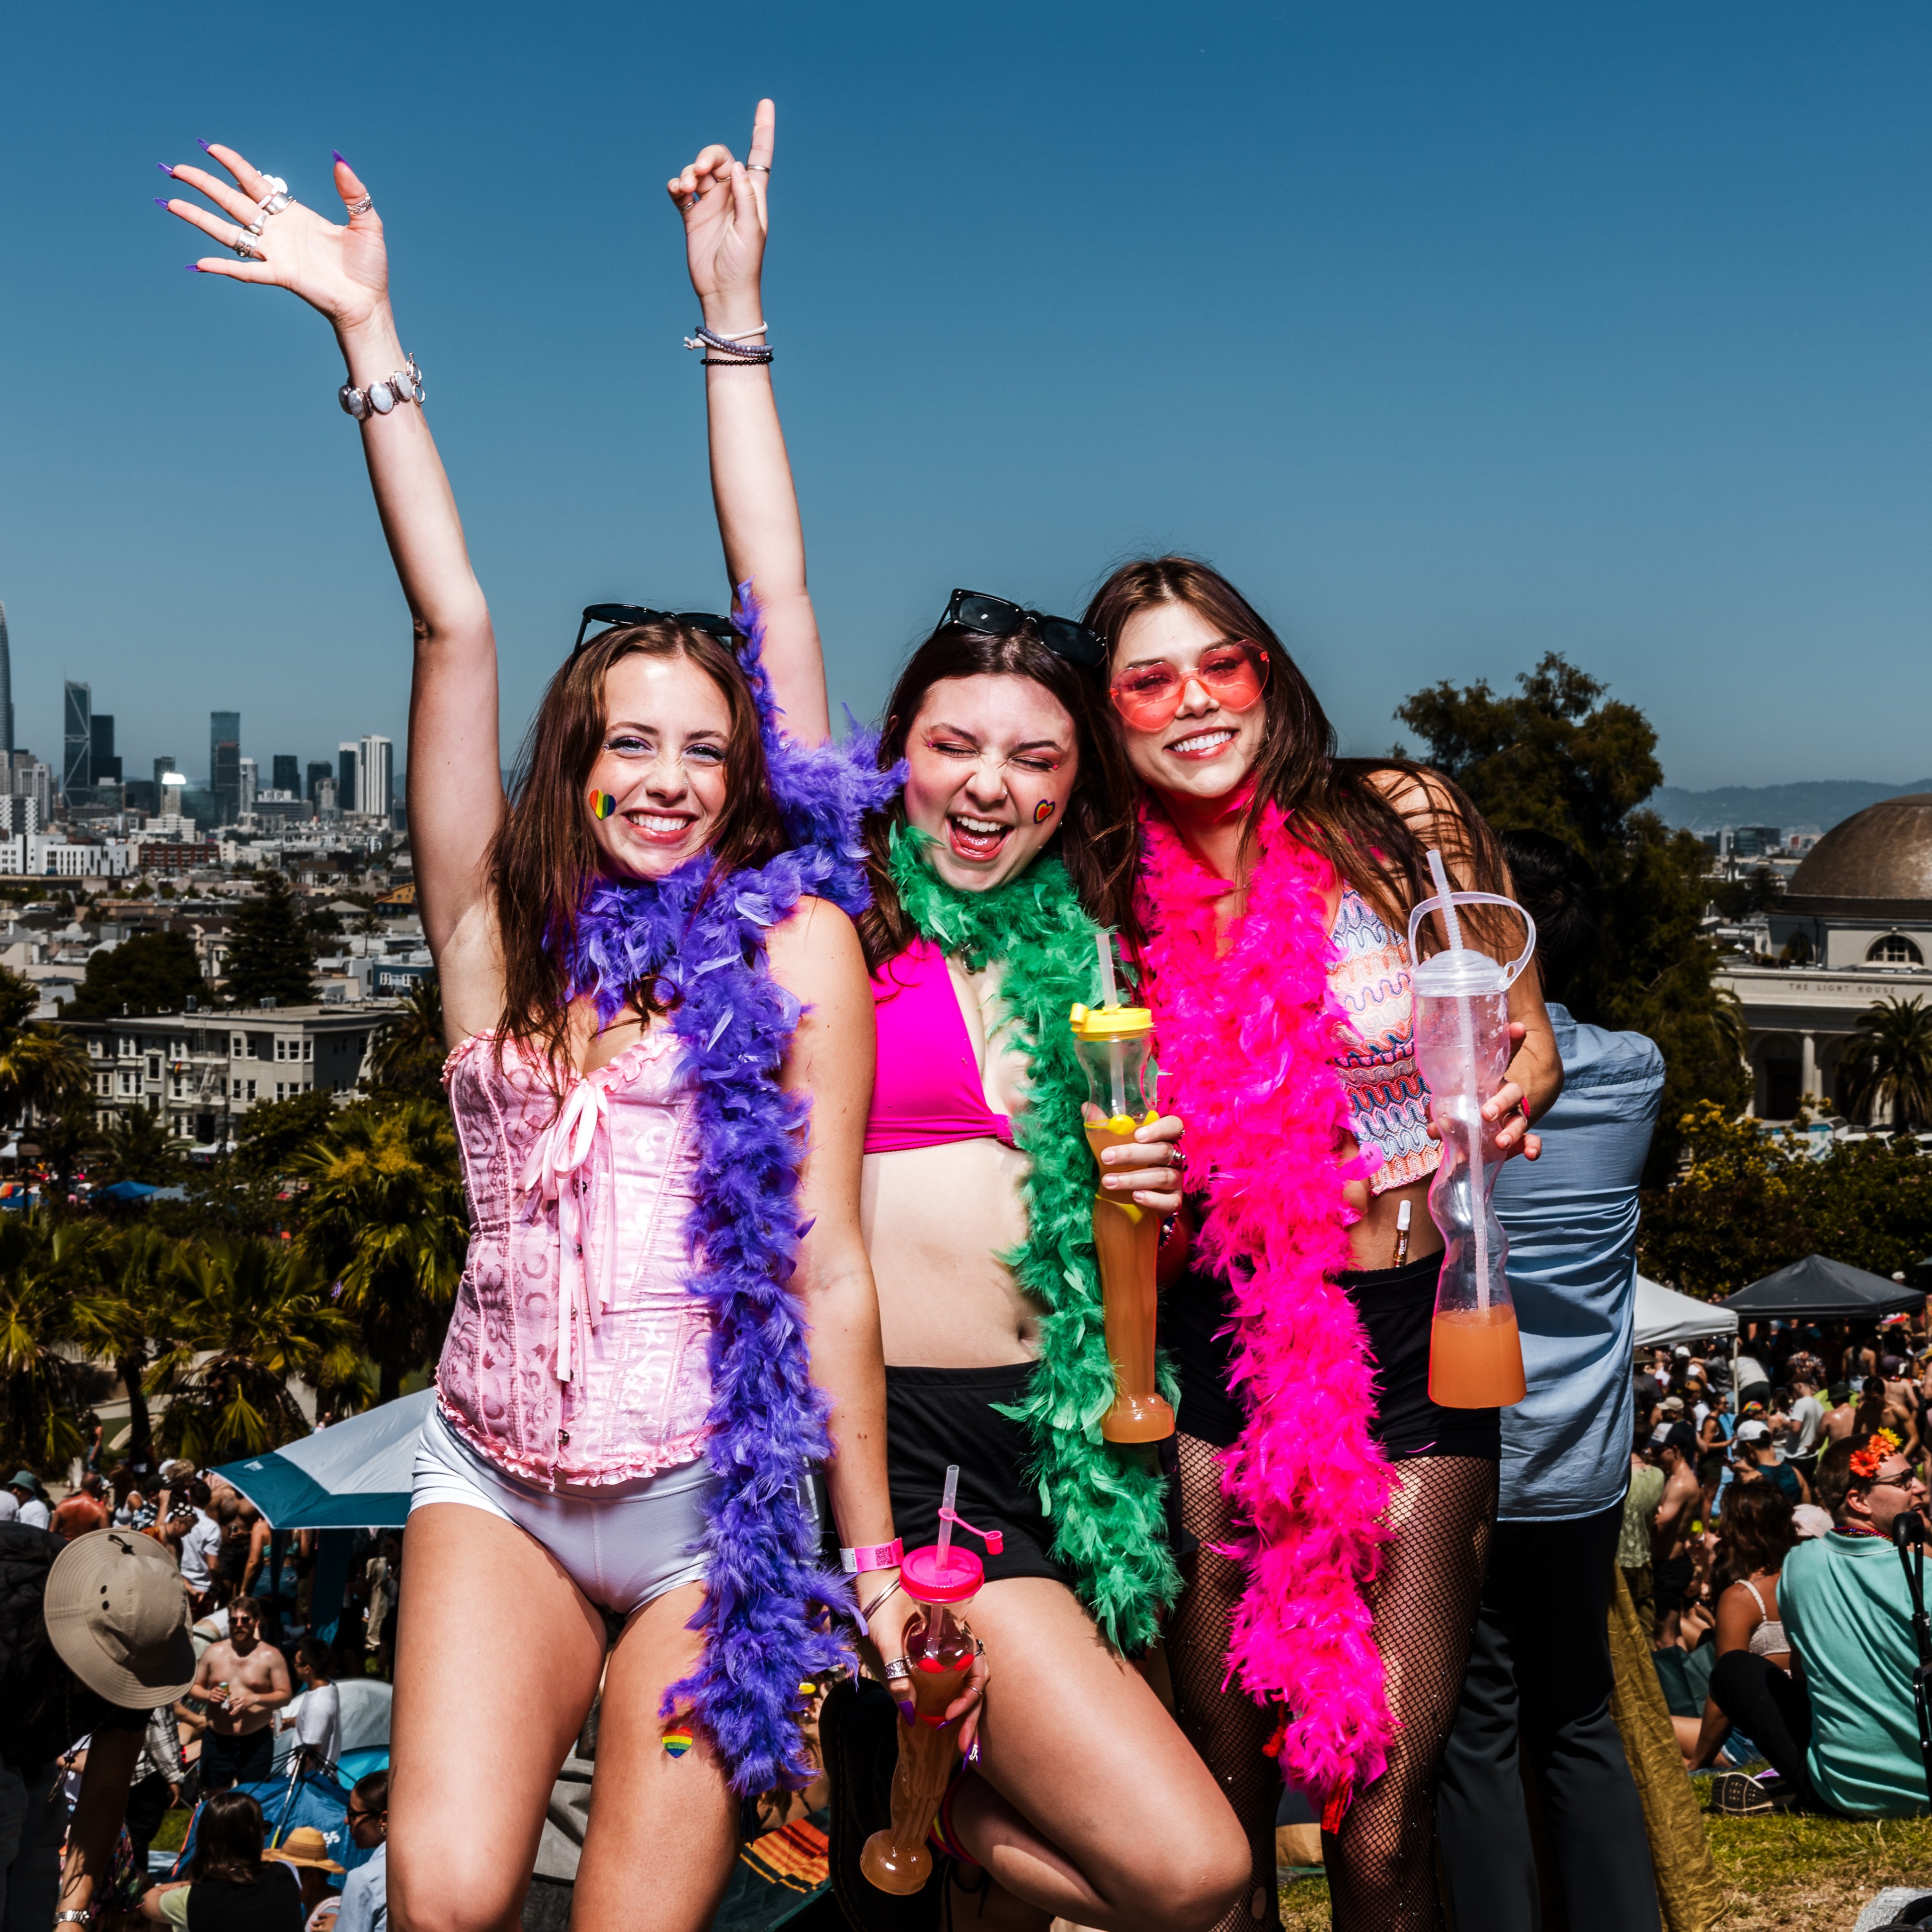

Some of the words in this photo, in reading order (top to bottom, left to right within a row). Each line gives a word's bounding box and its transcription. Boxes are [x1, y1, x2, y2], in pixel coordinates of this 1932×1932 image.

[1789, 983, 1808, 991] THE
[1817, 984, 1849, 992] LIGHT
[1857, 986, 1896, 994] HOUSE
